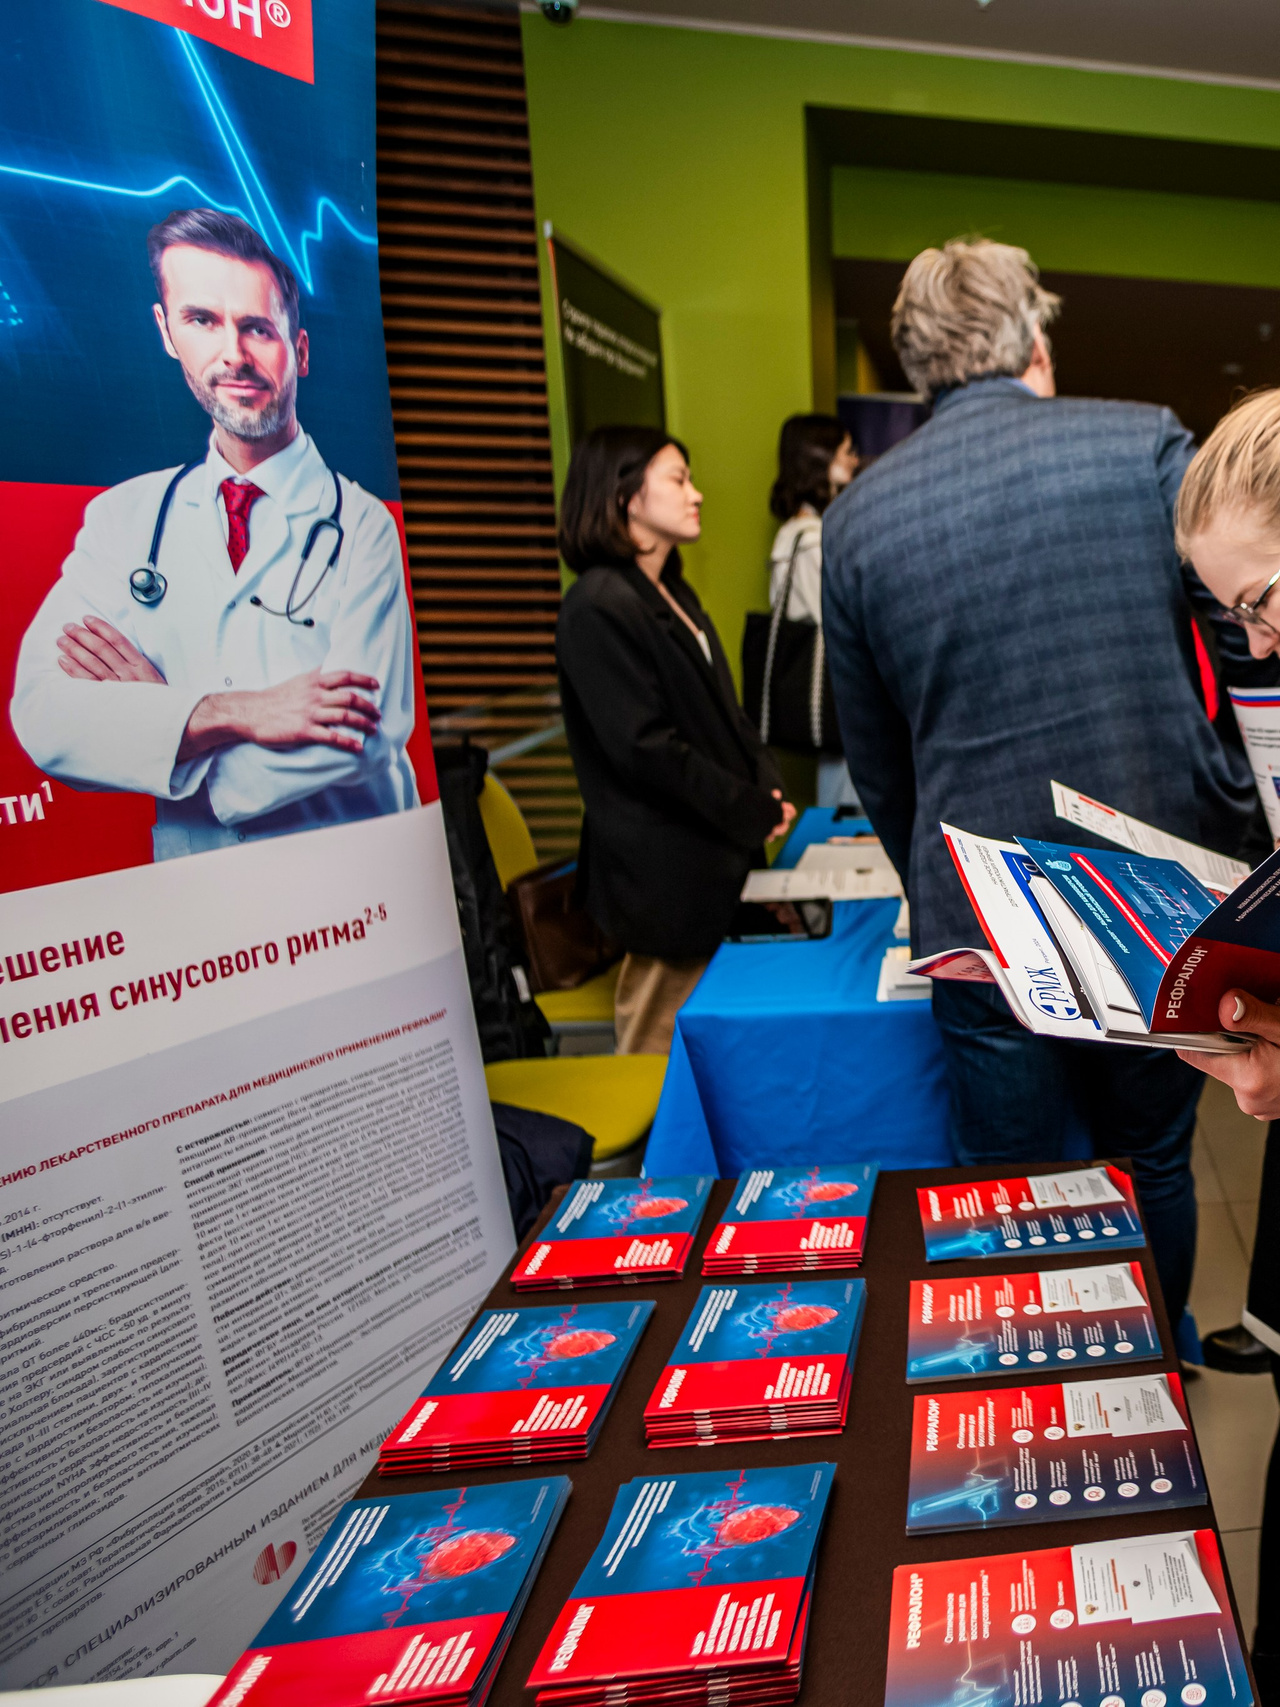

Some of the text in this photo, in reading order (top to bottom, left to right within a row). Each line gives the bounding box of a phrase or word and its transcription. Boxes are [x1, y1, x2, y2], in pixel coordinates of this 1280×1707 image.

[0, 781, 53, 825] ти1
[0, 930, 125, 985] шение
[110, 941, 279, 1011] синусового
[0, 1164, 37, 1187] НИЮ
[38, 1118, 160, 1172] ЛЕКАРСТВЕННОГО
[161, 1092, 228, 1125] ПРЕПАРАТА
[228, 1082, 251, 1100] ДЛЯ
[0, 1206, 31, 1226] .2014
[0, 1195, 104, 1243] (МНН): отсутствует.
[66, 1235, 114, 1261] раствора
[115, 1226, 134, 1240] для
[0, 1298, 71, 1339] фибрилляции
[81, 1267, 139, 1297] трепетания
[67, 1262, 117, 1288] средство.
[0, 1311, 71, 1351] ардиоверсии
[72, 1269, 158, 1314] персистирующей
[0, 1337, 45, 1366] ритмий.
[7, 1387, 54, 1415] Холтеру;
[55, 1362, 100, 1390] синдром
[100, 1339, 145, 1366] слабости
[19, 1354, 36, 1369] QT
[37, 1340, 70, 1361] более
[71, 1322, 107, 1343] 440мс;
[20, 1345, 84, 1383] предсердий
[93, 1328, 116, 1343] ЧСС
[117, 1318, 136, 1332] <50
[136, 1313, 149, 1325] уд.
[22, 1375, 46, 1394] ЭКГ
[48, 1366, 69, 1381] или
[70, 1332, 135, 1370] выявленные
[0, 1401, 74, 1446] исключением
[75, 1371, 129, 1404] пациентов
[26, 1424, 50, 1444] II-III
[52, 1401, 99, 1429] степени,
[49, 1374, 100, 1405] блокада),
[0, 1438, 77, 1485] ффективность
[84, 1396, 152, 1435] безопасность
[0, 1473, 57, 1510] оническая
[57, 1441, 110, 1476] сердечная
[110, 1397, 188, 1445] недостаточность
[23, 1392, 136, 1458] кардиостимулятором;
[55, 1467, 87, 1489] NYHA
[88, 1423, 164, 1471] эффективность
[66, 1416, 136, 1458] безопасность
[2, 1510, 36, 1534] астма
[37, 1449, 138, 1513] неконтролируемого
[137, 1426, 179, 1452] течения,
[91, 1449, 160, 1492] безопасность
[5, 1493, 128, 1570] сердечных гликозидов.
[12, 1496, 101, 1554] вскармливания;
[102, 1474, 135, 1499] прием
[63, 1523, 257, 1667] СПЕЦИАЛИЗИРОВАННЫМ
[259, 1471, 330, 1528] ИЗДАНИЕМ
[333, 1452, 358, 1479] ДЛЯ
